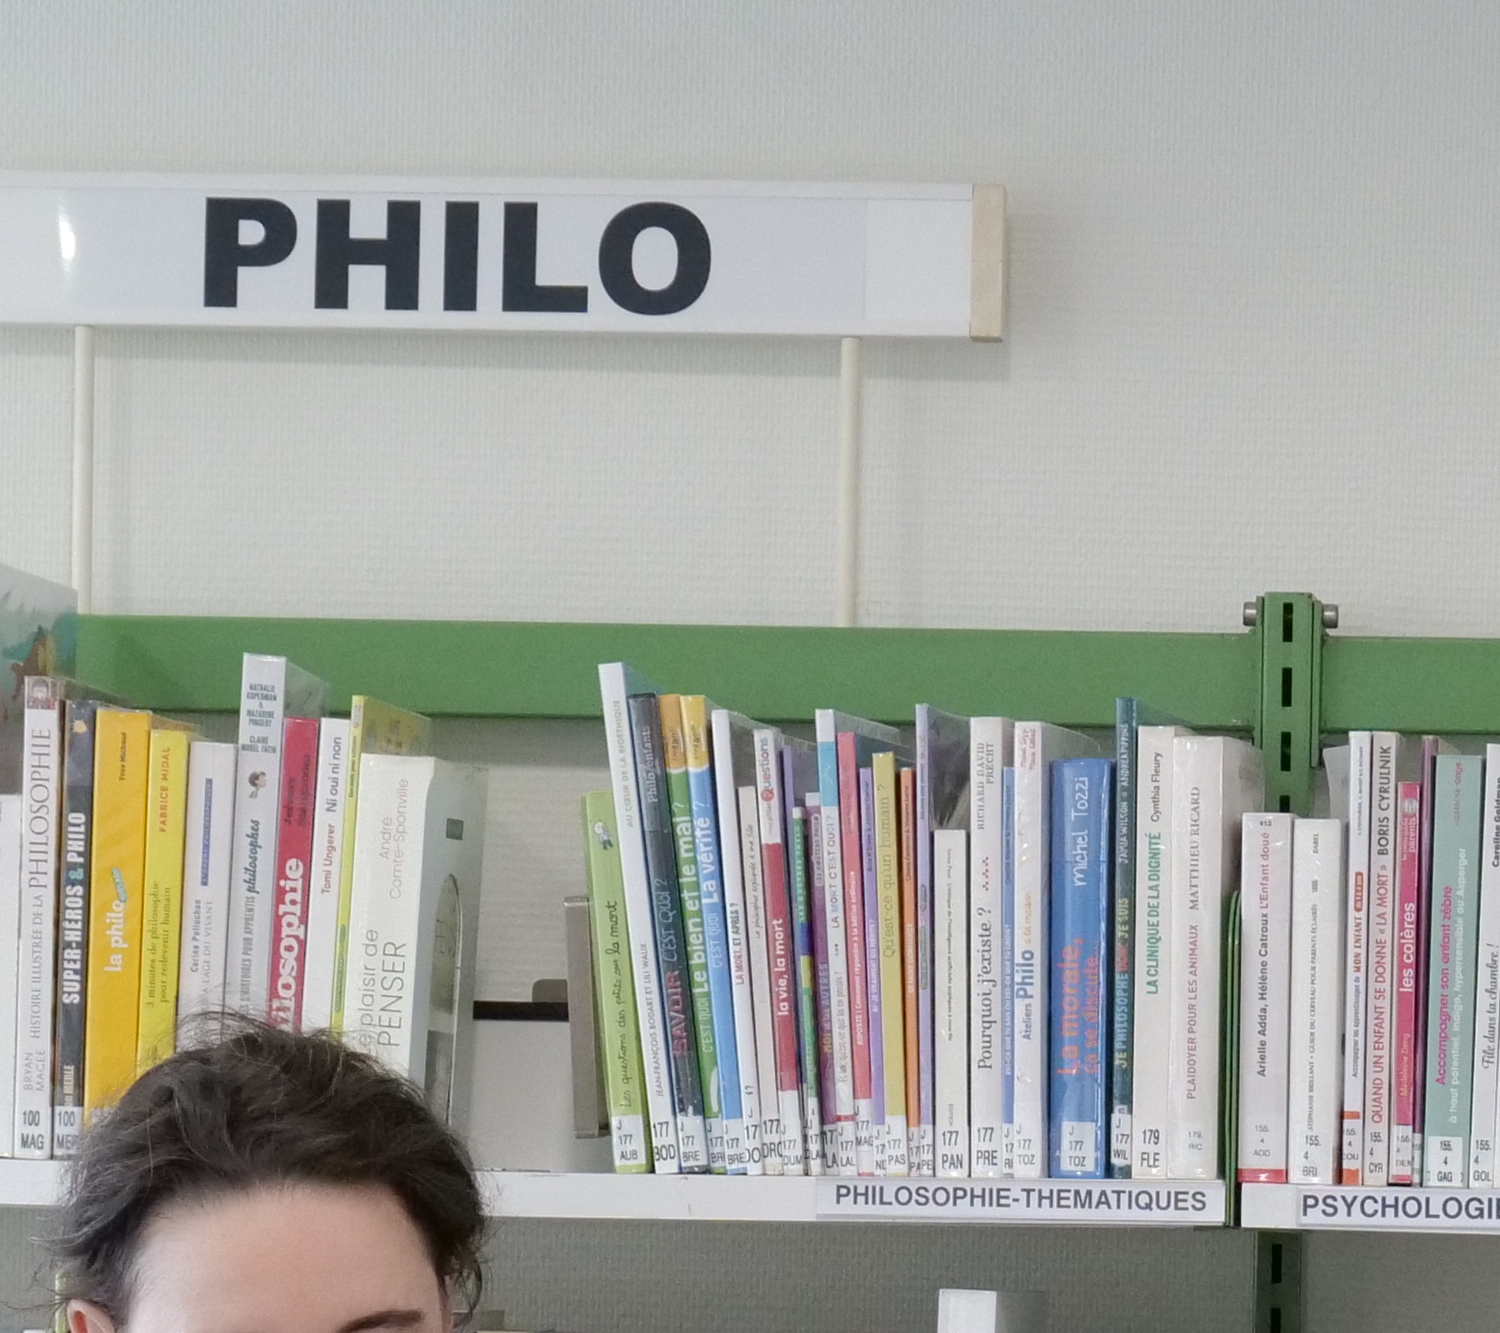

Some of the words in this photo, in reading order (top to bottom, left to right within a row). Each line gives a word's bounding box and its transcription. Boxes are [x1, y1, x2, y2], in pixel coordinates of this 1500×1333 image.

[203, 197, 712, 316] PHILO
[66, 812, 87, 864] PHILO
[1401, 902, 1416, 963] colères
[1400, 966, 1414, 993] les
[978, 988, 997, 1070] Pourquoi
[1142, 1128, 1160, 1145] 179
[1141, 1151, 1160, 1169] FLE
[835, 1185, 1208, 1213] PHILOSOPHIE-THEMATIQUES
